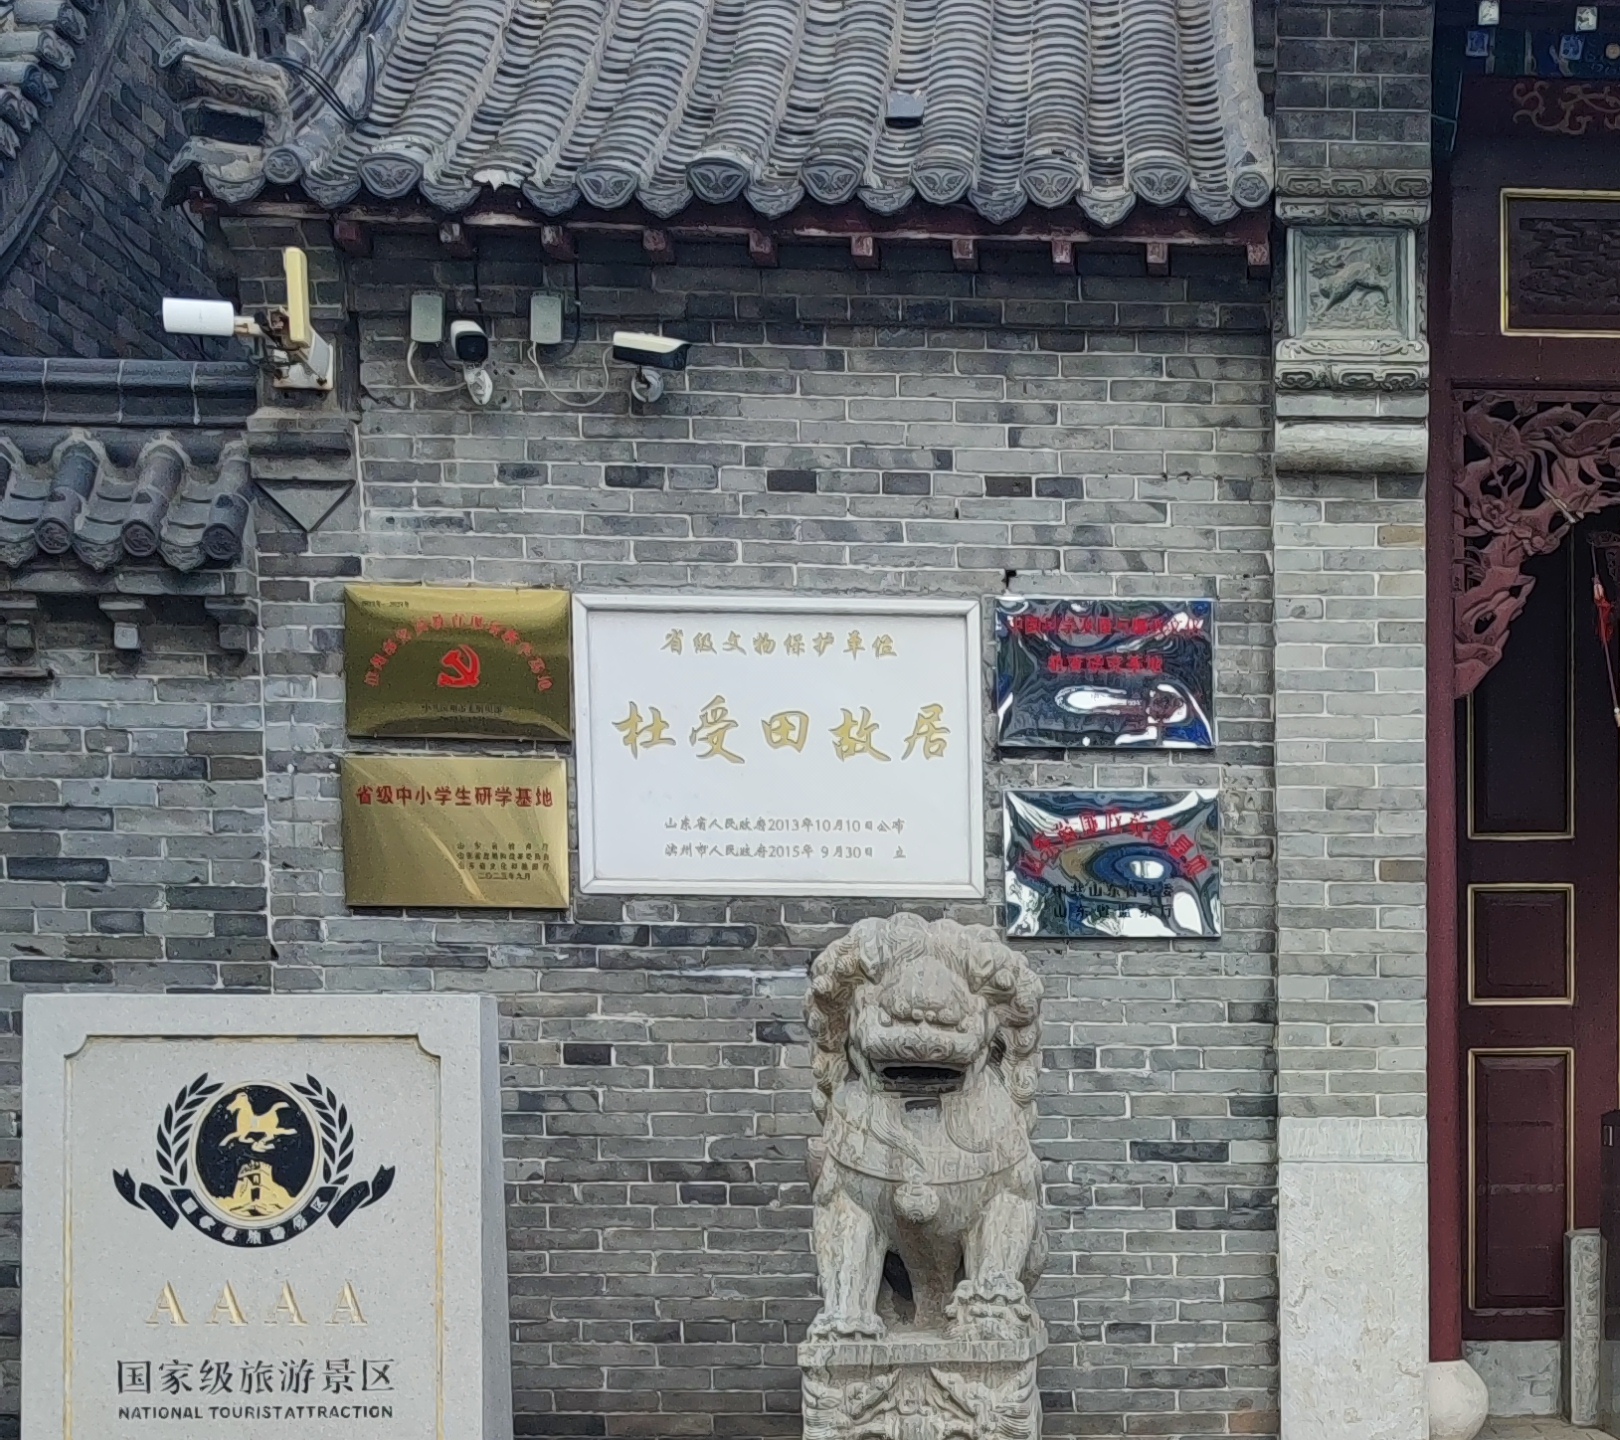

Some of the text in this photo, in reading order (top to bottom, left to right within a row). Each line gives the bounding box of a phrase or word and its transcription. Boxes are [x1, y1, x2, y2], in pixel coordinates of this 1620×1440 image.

[659, 628, 899, 659] 省级文物保护单位
[611, 693, 953, 764] 杜受田故居
[356, 784, 554, 808] 省级中小学生研学基地
[664, 815, 906, 834] 山东省人民政府2013年10月10日公布
[116, 1358, 396, 1396] 国家级旅游景区
[119, 1405, 204, 1420] NATIONAL
